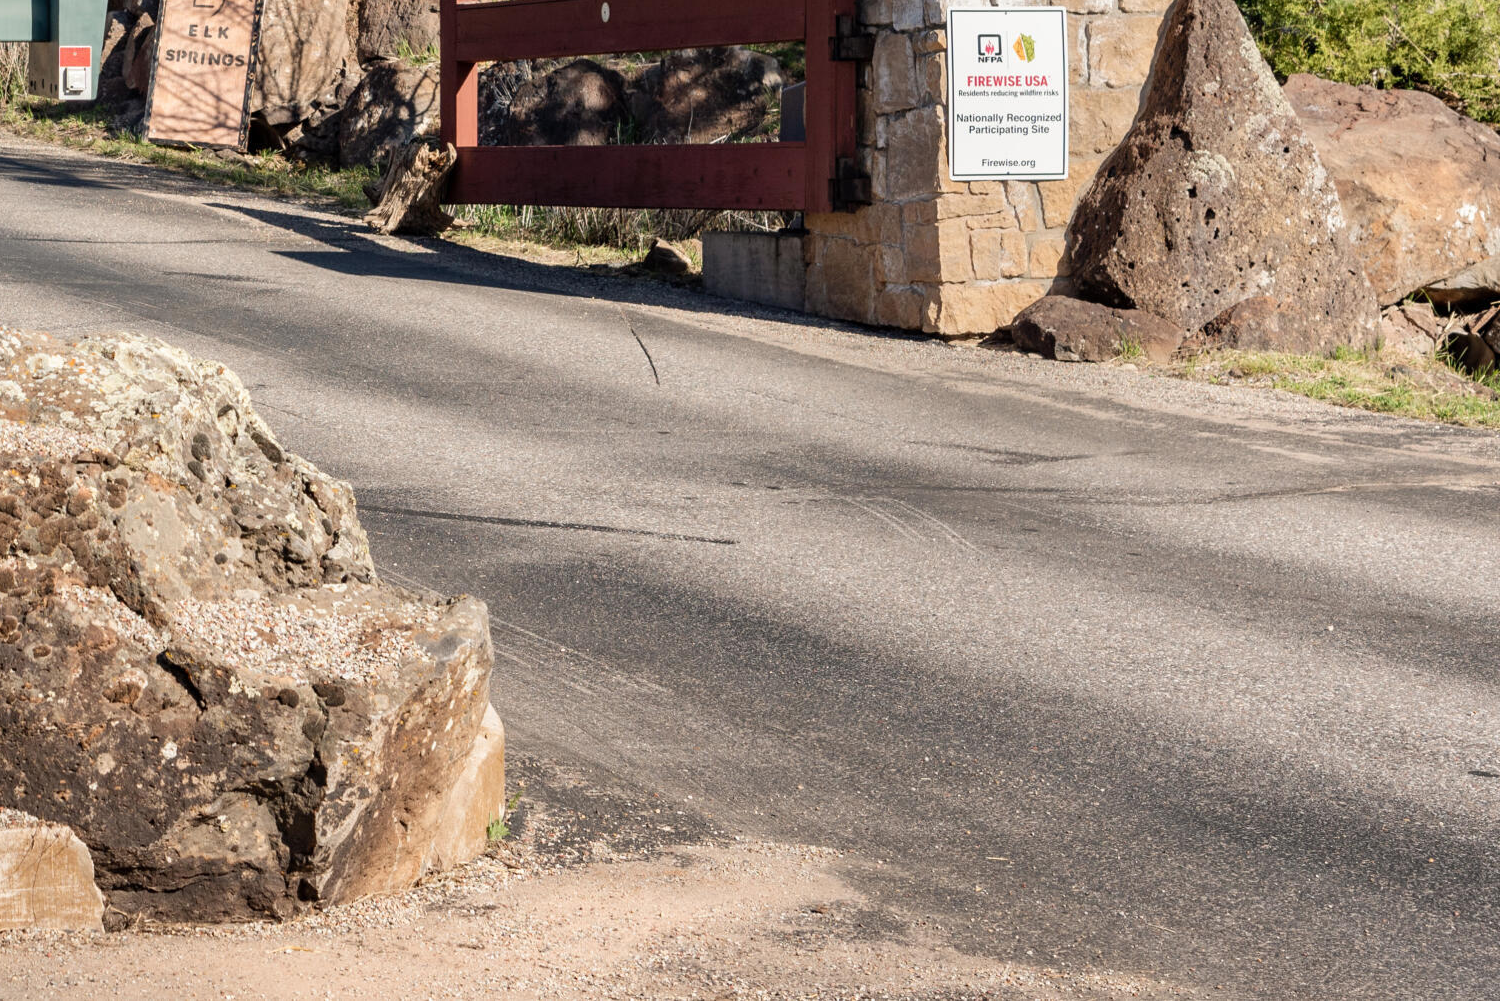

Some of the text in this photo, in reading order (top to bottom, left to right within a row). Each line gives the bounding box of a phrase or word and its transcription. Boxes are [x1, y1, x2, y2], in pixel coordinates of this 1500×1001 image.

[188, 24, 230, 40] ELK
[165, 49, 245, 67] SPRINGS
[967, 75, 1022, 87] FIREWISE
[956, 113, 1062, 124] Nationally Recognized
[969, 125, 1050, 136] Participating Site
[981, 159, 1036, 168] Firewise.org
